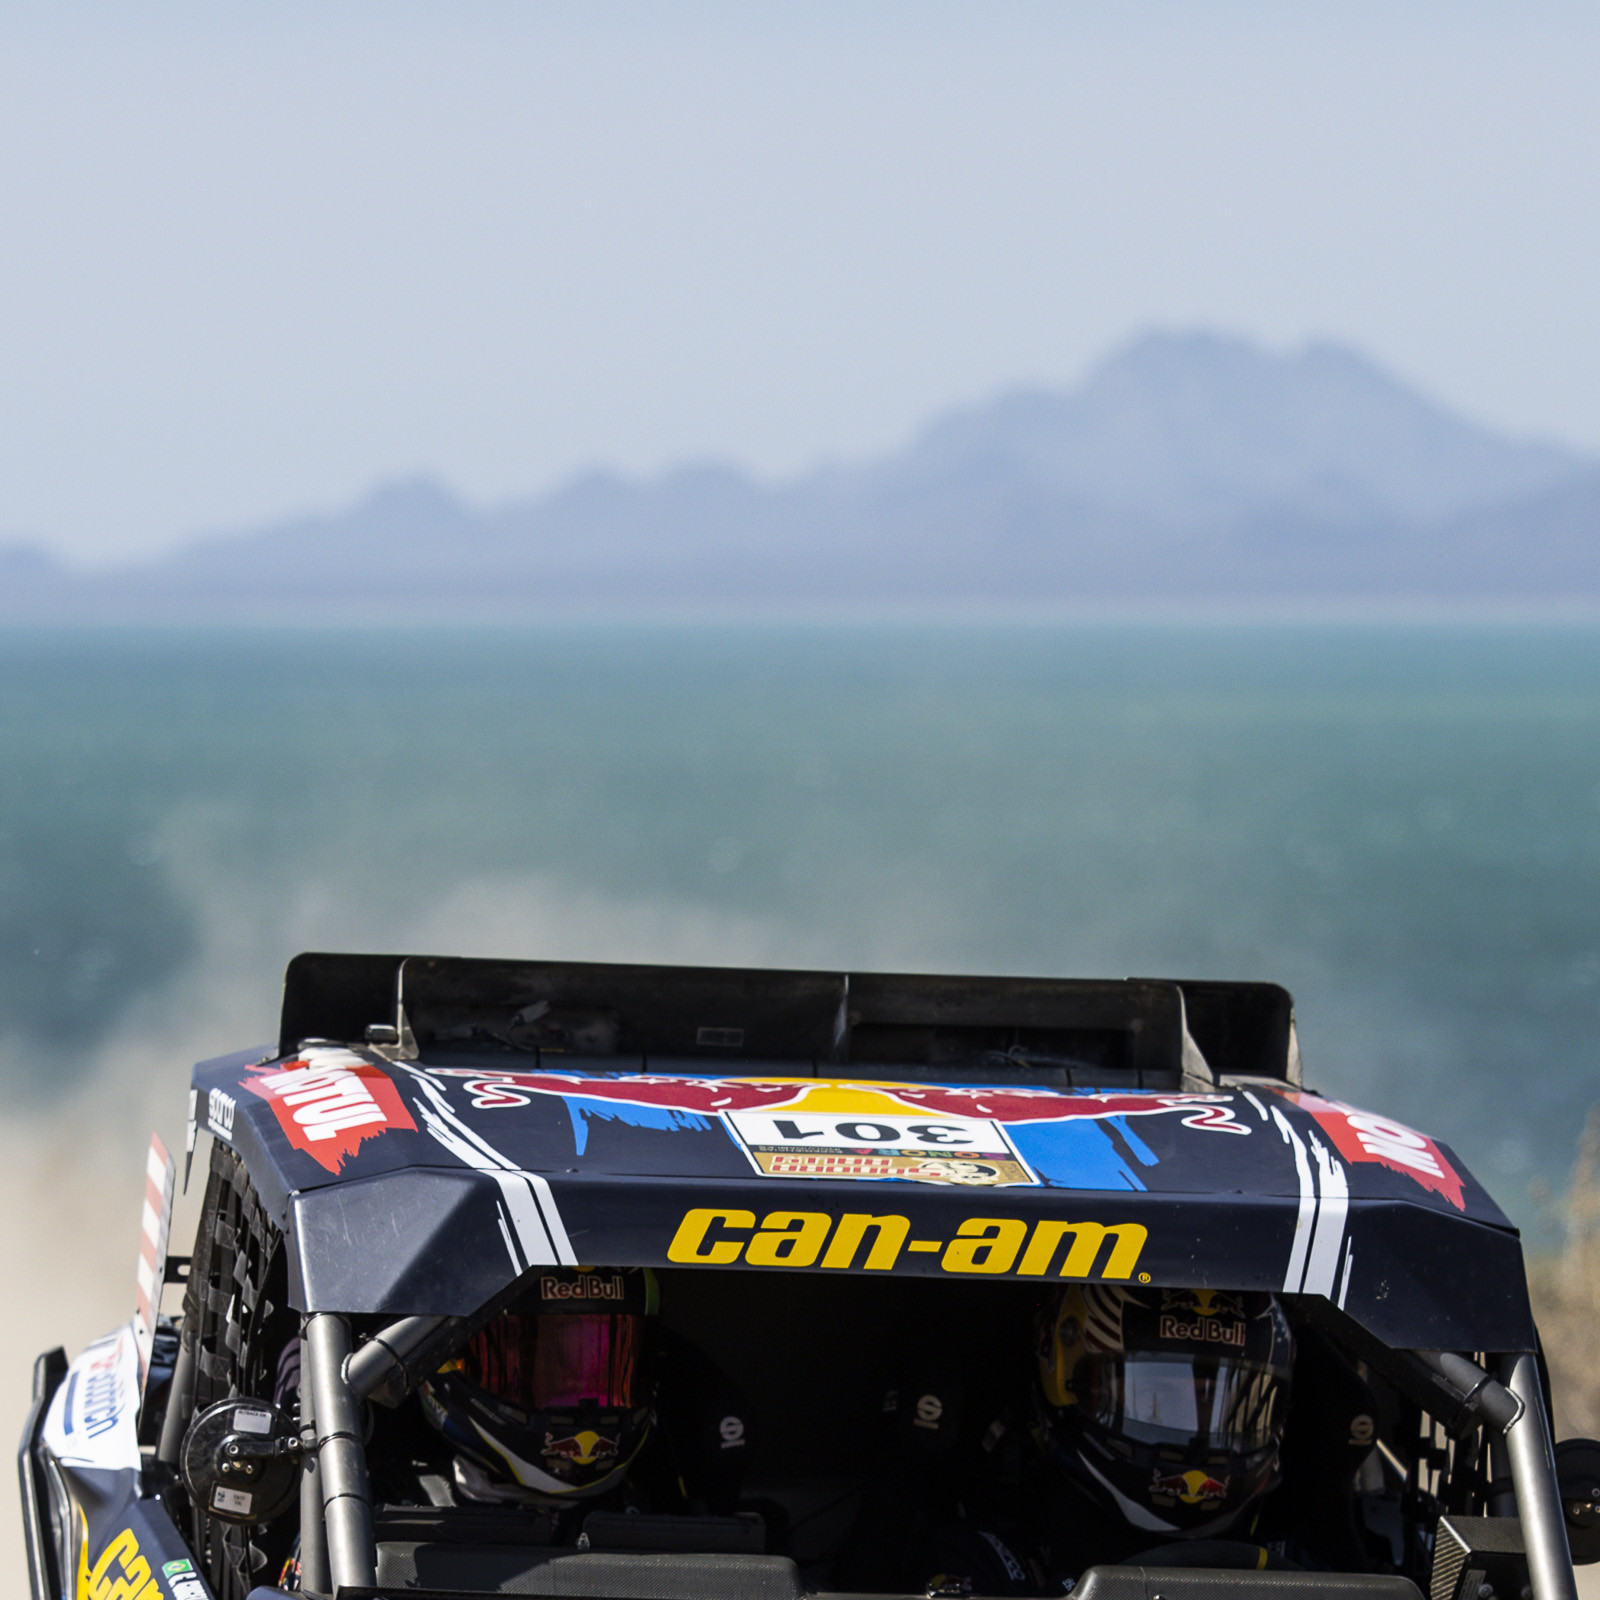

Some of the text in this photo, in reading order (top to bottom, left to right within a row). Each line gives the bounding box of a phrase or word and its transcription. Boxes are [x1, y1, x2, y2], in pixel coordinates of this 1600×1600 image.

[259, 1050, 388, 1142] MOTUL
[773, 1119, 974, 1145] 301
[667, 1208, 1148, 1280] can-am
[541, 1275, 625, 1300] Red Bull
[1160, 1315, 1247, 1346] Red Bull
